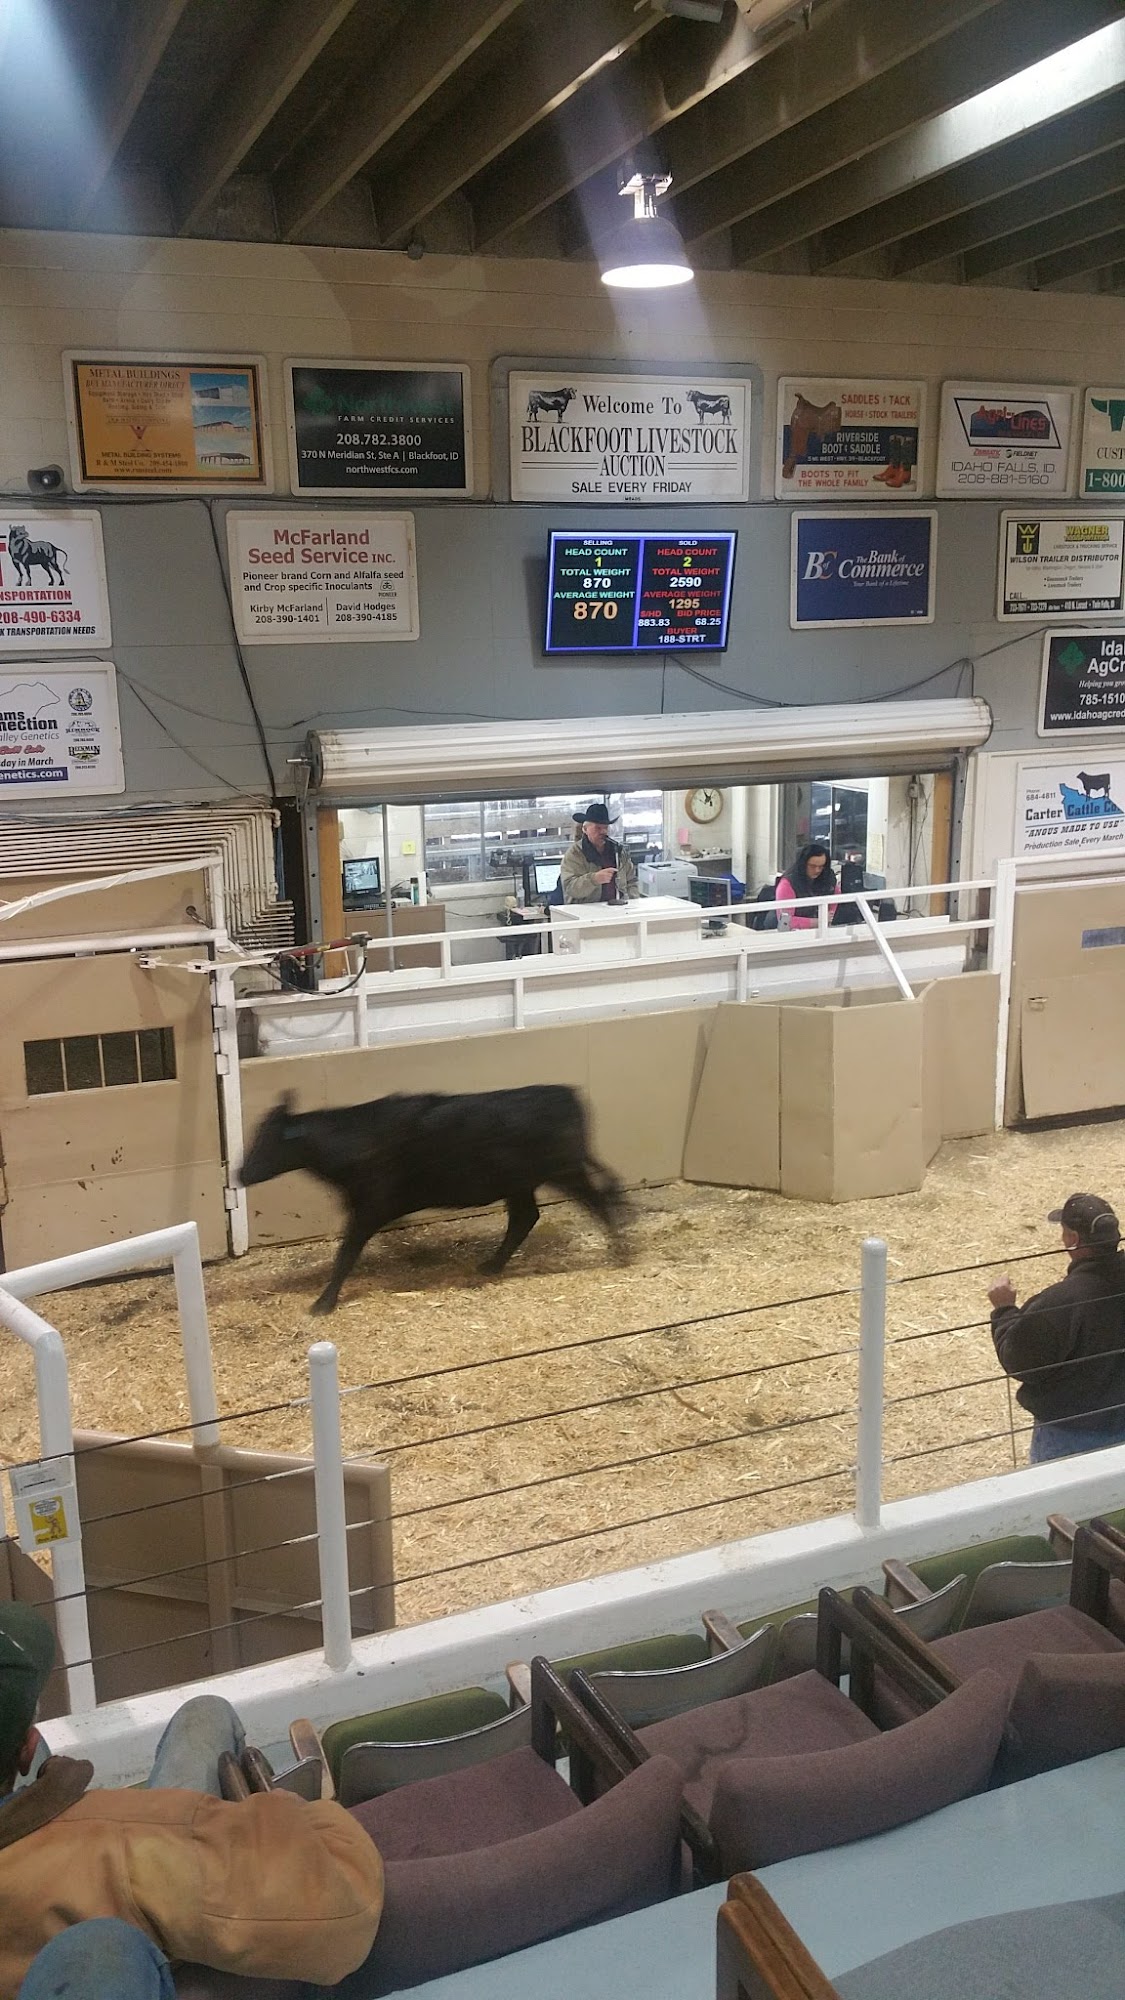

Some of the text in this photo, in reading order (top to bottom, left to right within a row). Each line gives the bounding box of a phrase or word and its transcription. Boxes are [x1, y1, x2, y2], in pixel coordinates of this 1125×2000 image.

[90, 368, 180, 380] METAL BUILDINGS
[582, 395, 682, 414] Welcome To
[841, 394, 910, 406] SADDLES TACK
[409, 416, 454, 424] SERVICES
[868, 410, 888, 418] STOCK
[891, 410, 918, 420] TRAILERS
[336, 433, 422, 446] 208.782.3800
[520, 426, 738, 454] BLACKFOOT LIVESTOCK
[836, 432, 878, 442] RIVERSIDE
[822, 443, 880, 454] BOOT SADDLE
[301, 450, 458, 462] 370 N Meridian St, Ste A Blackfoot, ID
[346, 465, 418, 474] northwestfcs.com
[599, 454, 666, 476] AUCTION
[952, 461, 1057, 474] IDAHO FALLS, ID.
[802, 470, 859, 478] BOOTS TO FIT
[958, 474, 1049, 485] 208-881-5160
[572, 480, 692, 493] SALE EVERY FRIDAY
[1065, 524, 1109, 536] WAGNER
[274, 529, 370, 545] McFarland
[248, 548, 396, 564] Seed Service INC.
[565, 548, 628, 556] HEAD COUNT
[657, 548, 718, 556] HEAD COUNT
[868, 550, 898, 564] Bank
[595, 557, 602, 567] 1
[683, 557, 692, 567] 2
[1010, 554, 1119, 564] WILSON TRAILER DISTRIBUTOR
[560, 568, 630, 576] TOTAL WEIGHT
[838, 559, 924, 579] Commerce
[243, 570, 404, 580] Pioneer brand Corn and Alfalfa seed
[583, 578, 612, 588] 870
[670, 576, 702, 588] 2590
[244, 582, 372, 593] and Crop specific Inoculants
[554, 591, 598, 599] AVERAGE
[688, 590, 722, 598] WEIGHT
[336, 603, 396, 612] David Hodges
[669, 598, 700, 609] 1295
[250, 604, 324, 614] Kirby McFarland
[574, 602, 618, 620] 870
[255, 615, 320, 624] 208-390-1401
[336, 614, 398, 622] 208-390-4185
[695, 618, 722, 626] 68.25
[6, 626, 96, 636] TRANSPORTATION NEEDS
[658, 634, 706, 644] 188-STRT
[1101, 640, 1125, 656] Ida
[1079, 680, 1113, 690] Helping you
[1080, 693, 1125, 706] 785-1510
[20, 732, 60, 740] Genetics
[18, 757, 54, 766] in March
[1026, 792, 1056, 801] 684-4811
[1025, 808, 1063, 821] Carter
[1067, 802, 1100, 817] Cattle
[1061, 824, 1087, 836] MADE
[1089, 822, 1100, 832] TO
[1024, 833, 1124, 851] Production Sale Every March
